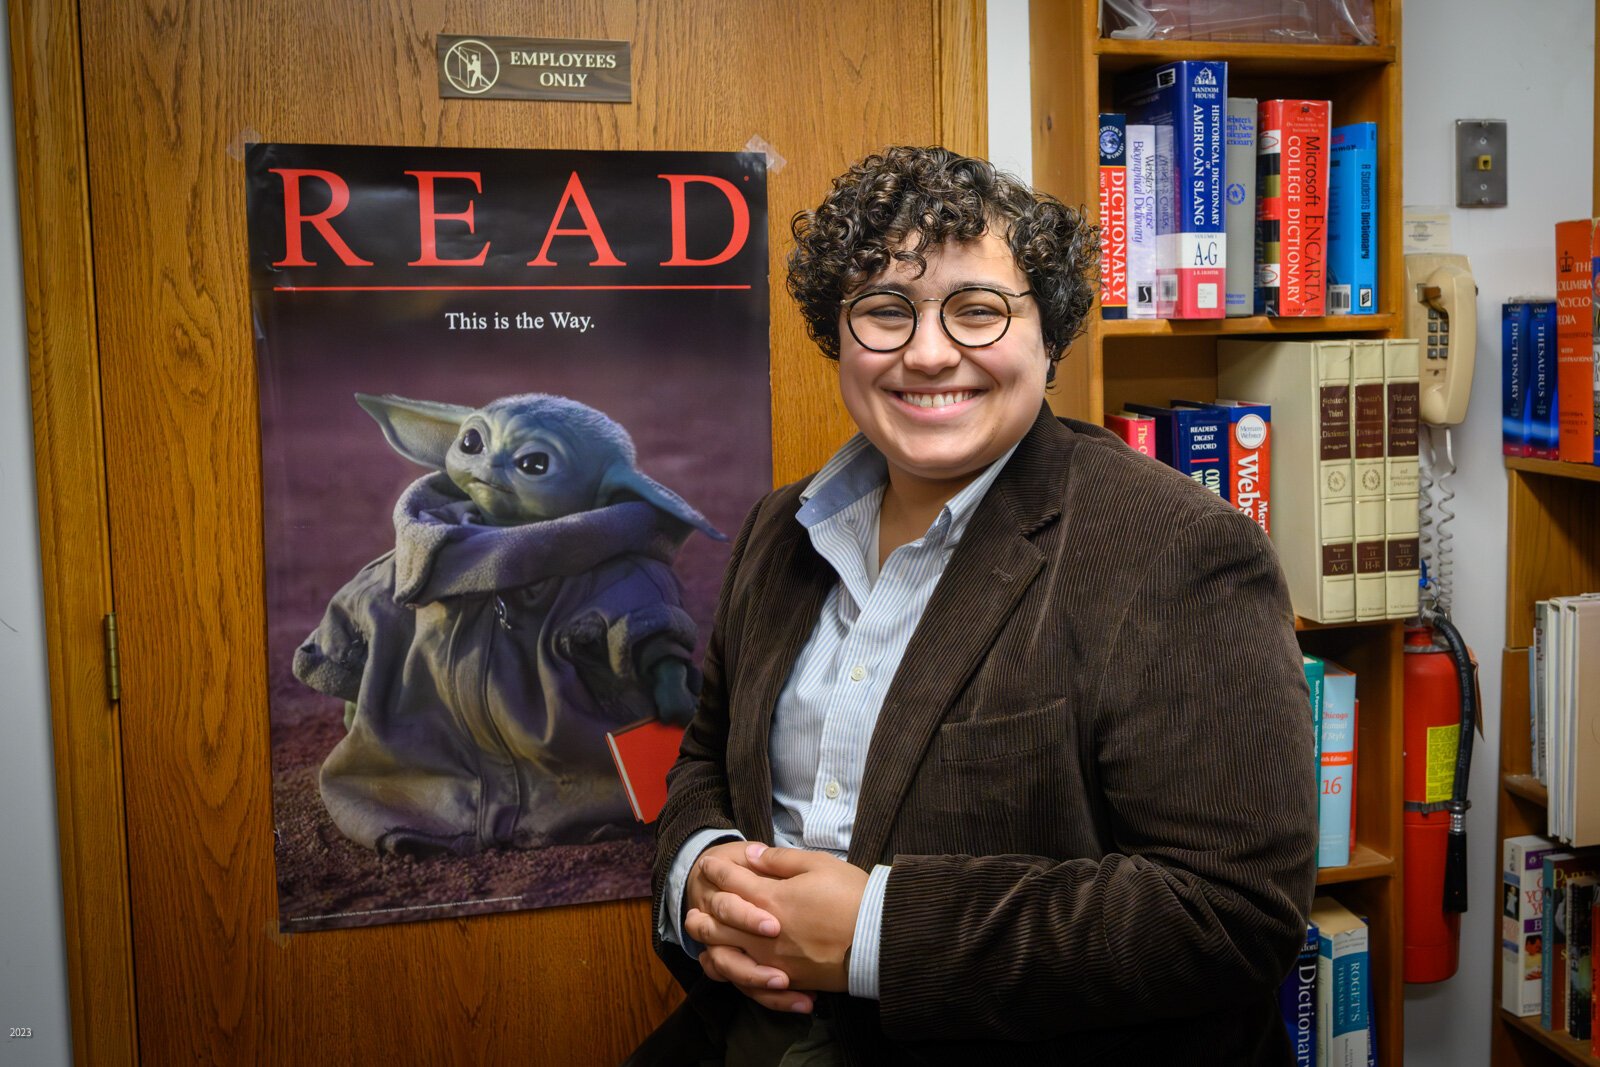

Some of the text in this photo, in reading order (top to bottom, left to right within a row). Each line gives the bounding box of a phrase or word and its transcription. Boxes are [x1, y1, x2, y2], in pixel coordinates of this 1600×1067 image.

[510, 50, 617, 69] EMPLOYEES
[539, 71, 588, 88] ONLY
[1194, 104, 1204, 226] AMERICAN SLANG
[1205, 161, 1211, 169] OF
[1212, 105, 1220, 226] HISTORICAL DICTIONARY
[1305, 137, 1320, 206] Microsoft
[1131, 142, 1145, 243] Biographical Dictionary
[268, 167, 750, 268] READ
[1111, 171, 1126, 299] DICTIONARY
[1287, 136, 1301, 304] COLLEGE DICTIONARY
[1361, 212, 1371, 259] Dictionary
[1194, 241, 1217, 266] A-G
[1304, 216, 1324, 304] ENCARTA
[1558, 279, 1592, 291] OLUMBIA
[1558, 296, 1592, 307] NCYCLO-
[445, 311, 595, 332] This is the Way.
[1558, 314, 1577, 324] EDIA
[1537, 325, 1545, 397] THESAURUS
[1138, 425, 1148, 444] The
[1194, 434, 1214, 442] DIGEST
[1322, 776, 1342, 794] 16
[1350, 962, 1360, 1022] ROGET'S
